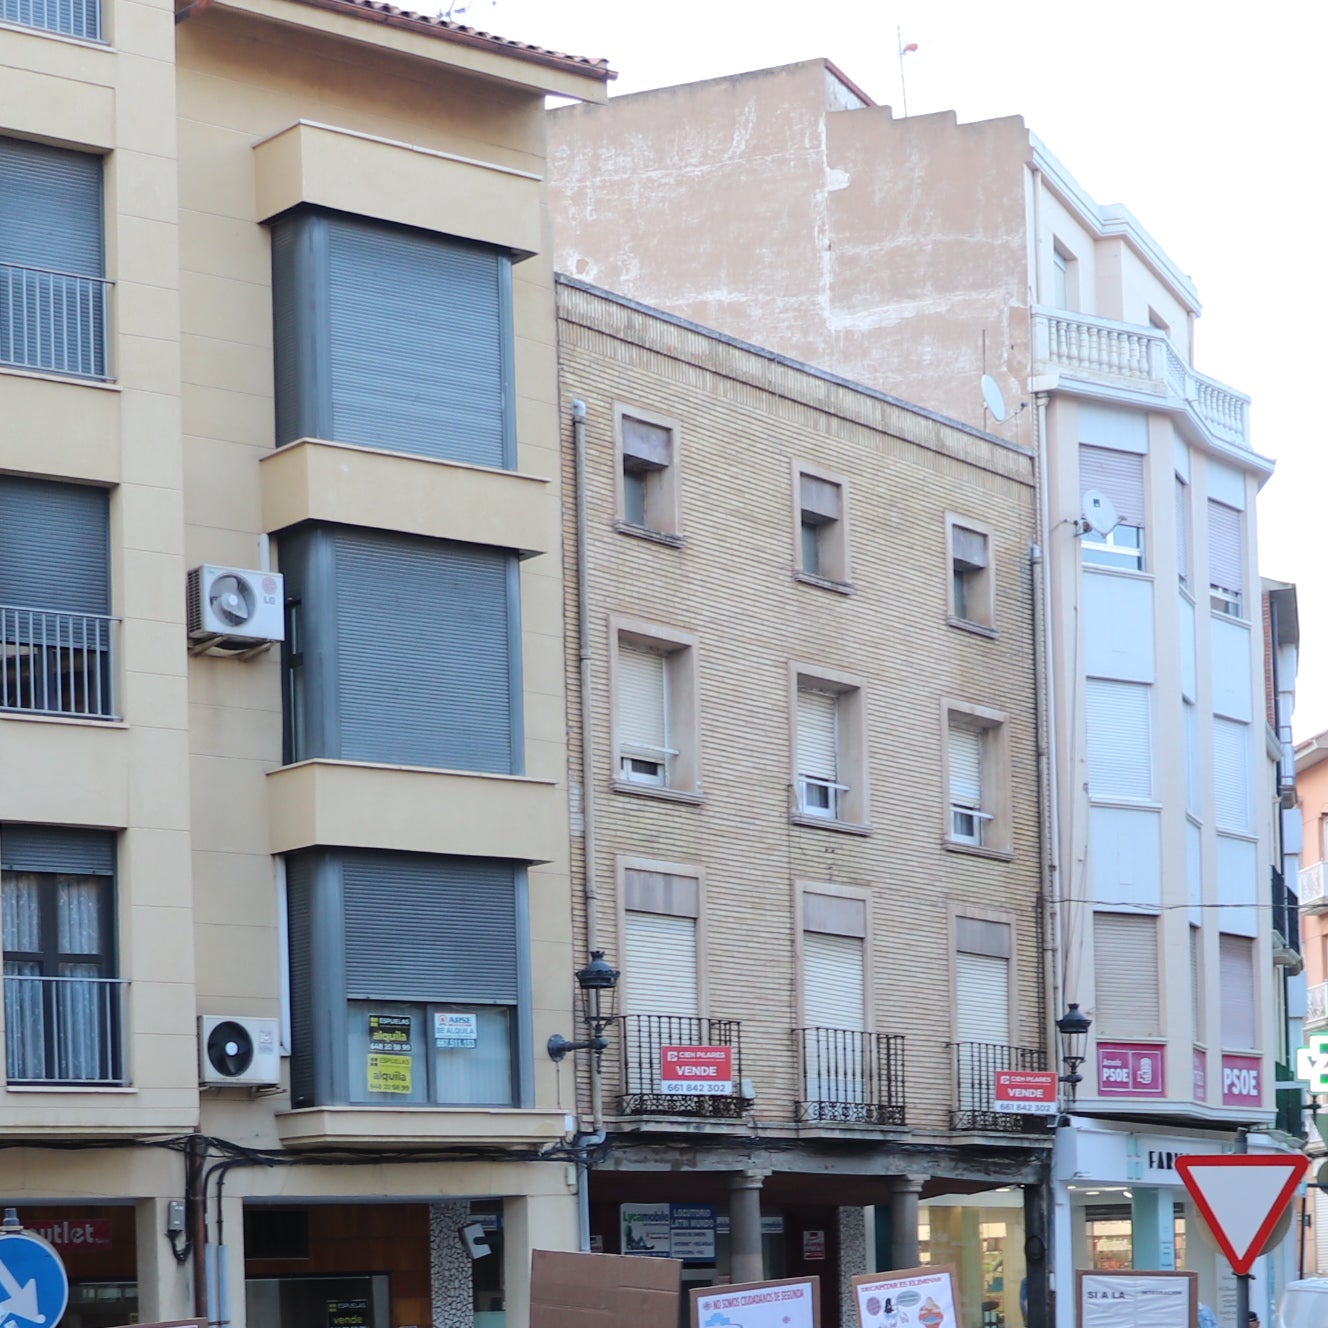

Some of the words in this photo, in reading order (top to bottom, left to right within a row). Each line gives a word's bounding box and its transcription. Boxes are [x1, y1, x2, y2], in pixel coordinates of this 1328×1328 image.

[264, 596, 275, 605] LG
[379, 1017, 410, 1025] ESPUELAS
[447, 1027, 475, 1035] ALQUILA
[373, 1030, 407, 1042] alquila
[675, 1065, 717, 1076] VENDE
[1102, 1068, 1129, 1082] PSOE
[373, 1070, 407, 1082] alquila
[1223, 1068, 1258, 1095] PSOE
[667, 1084, 684, 1092] 661
[686, 1084, 704, 1092] 842
[707, 1084, 726, 1092] 302
[1007, 1088, 1044, 1098] VENDE
[1034, 1104, 1051, 1112] 302
[674, 1208, 711, 1217] LOCUTORIO
[672, 1219, 687, 1228] LATIN
[689, 1219, 714, 1228] MUNDO
[861, 1282, 899, 1292] DECAPITAR
[900, 1280, 908, 1288] ES
[713, 1300, 721, 1310] NO
[722, 1297, 740, 1309] SOMOS
[740, 1293, 773, 1306] CIUDADANOS
[773, 1292, 781, 1302] DE
[781, 1288, 804, 1301] SEGUNDA
[1087, 1291, 1098, 1299] SI
[1101, 1291, 1109, 1299] A
[1112, 1291, 1126, 1299] LA
[334, 1315, 363, 1324] vende
